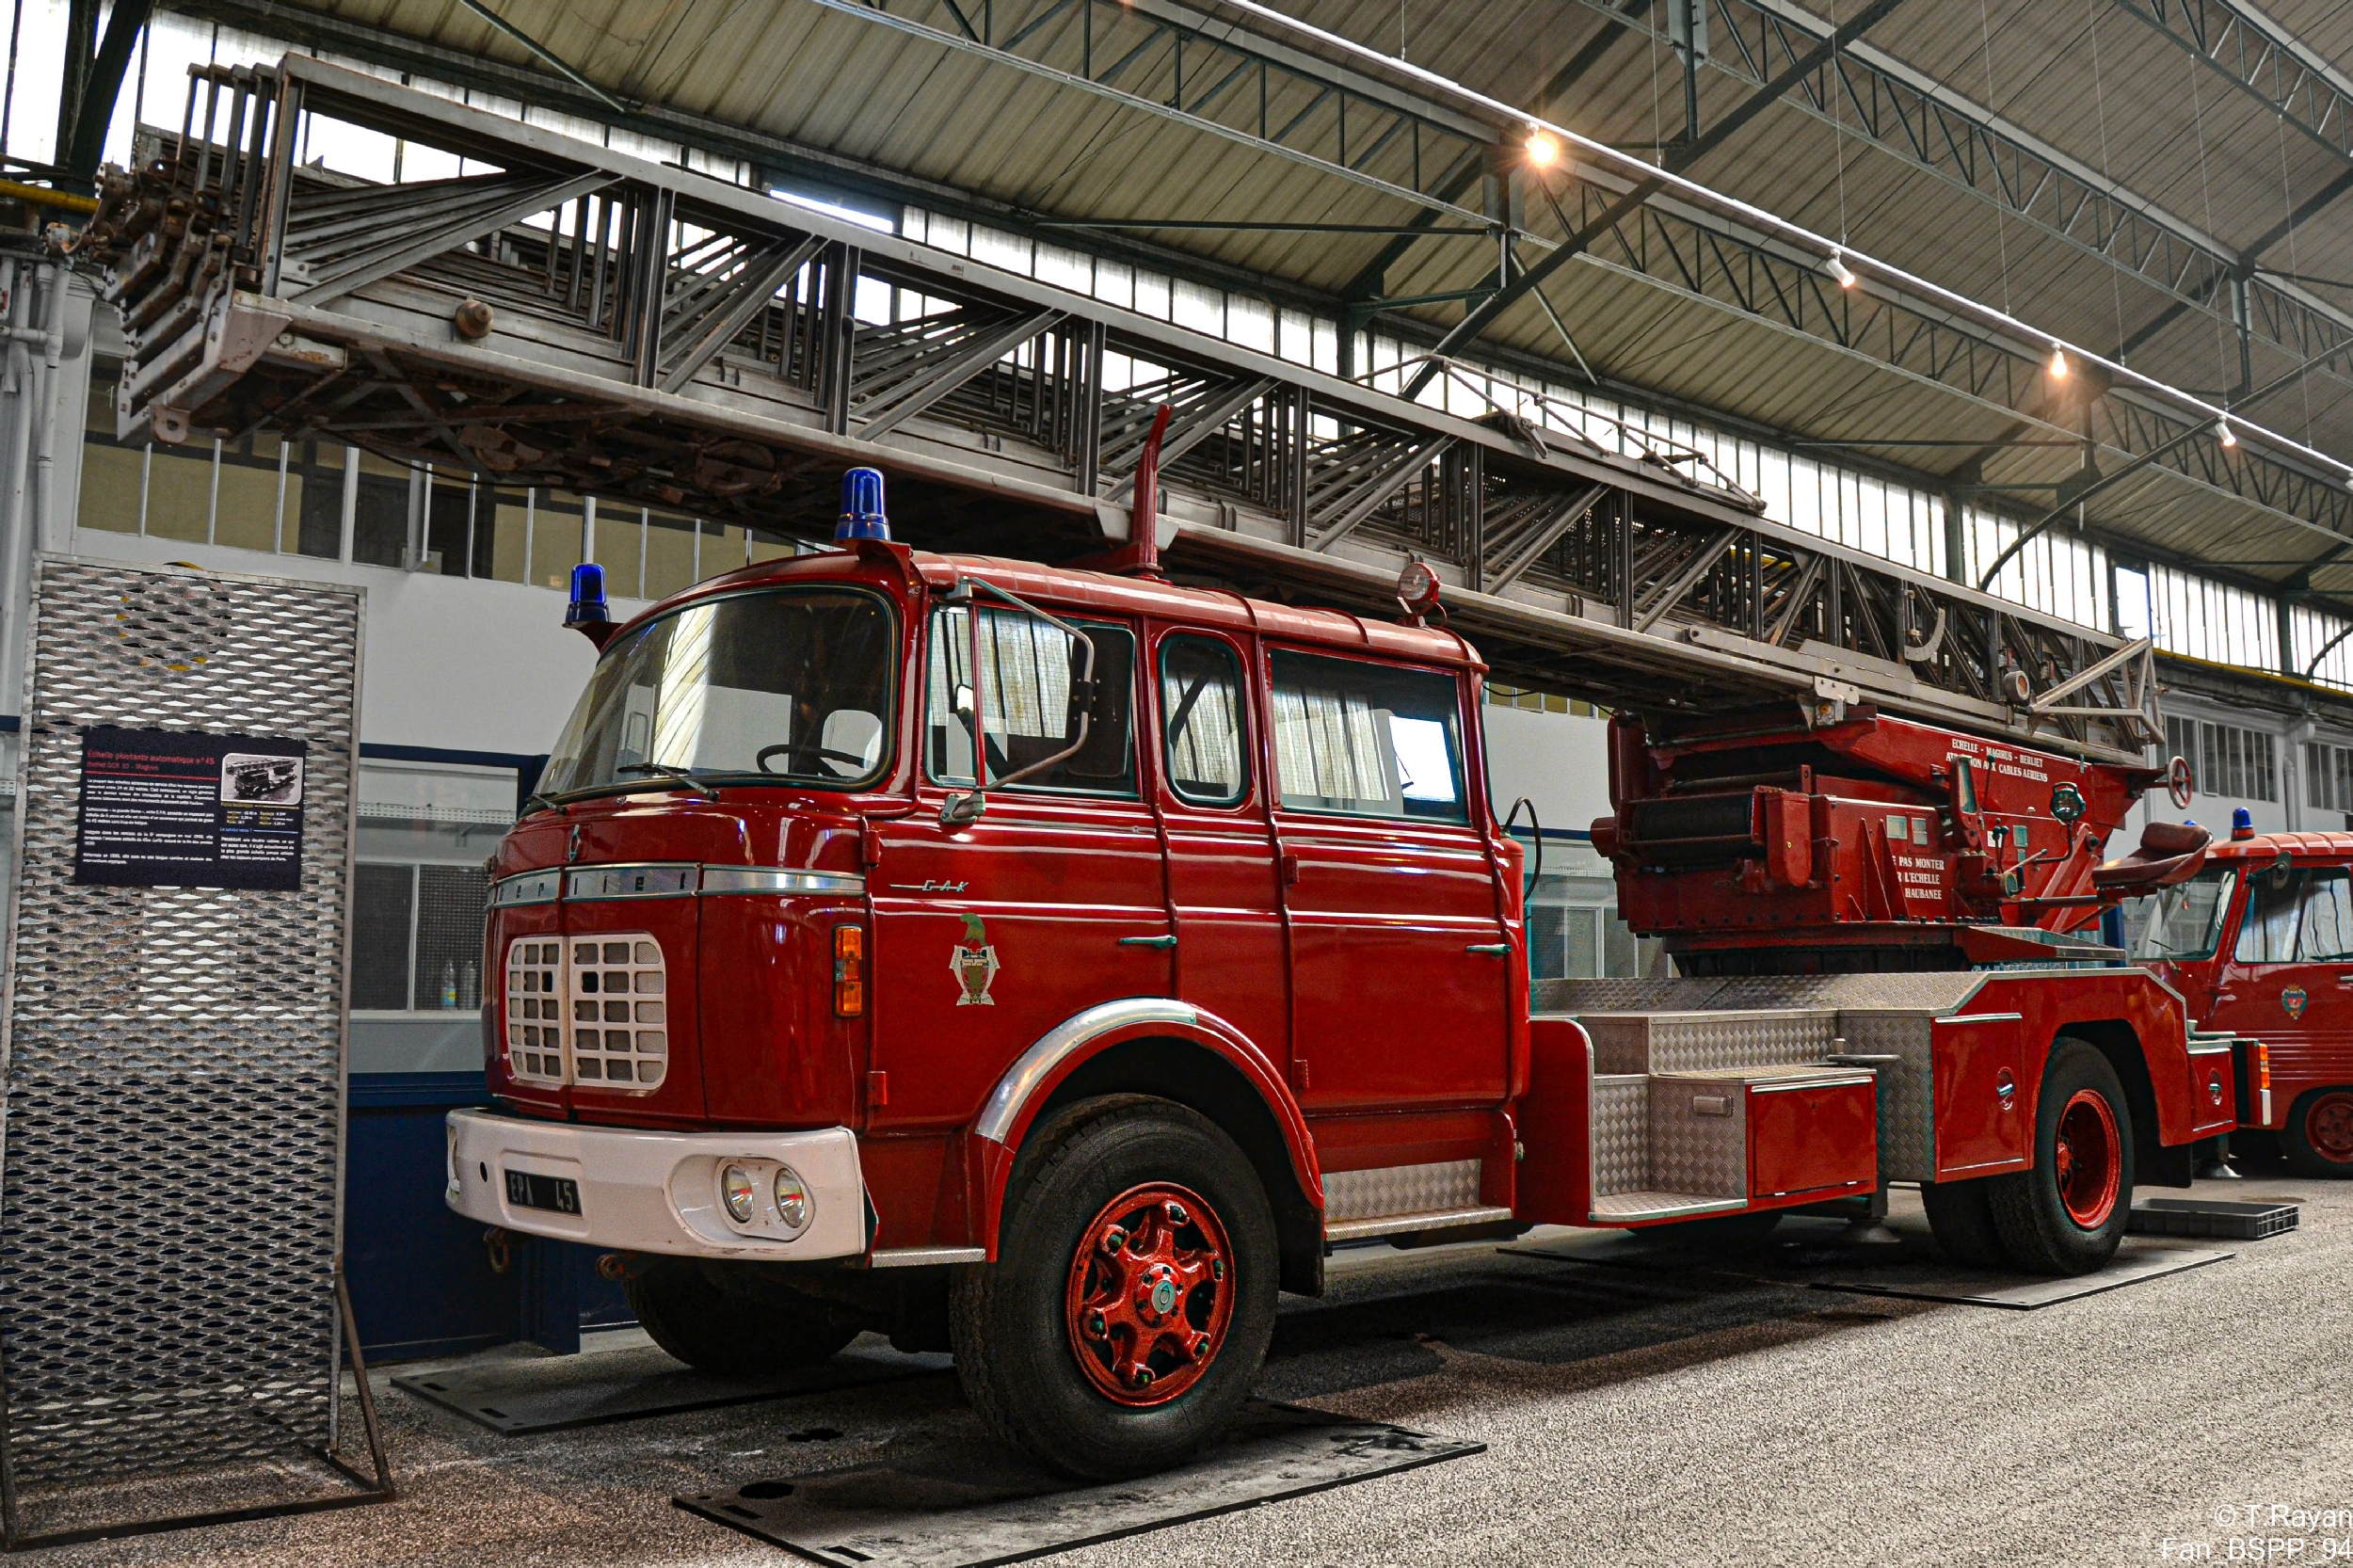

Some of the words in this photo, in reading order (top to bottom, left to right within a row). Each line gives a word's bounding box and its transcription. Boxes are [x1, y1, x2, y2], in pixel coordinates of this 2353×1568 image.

[1952, 739, 1978, 753] ECHELLE
[1986, 746, 2013, 761] MAGIRUS
[2020, 755, 2043, 768] BERLIET
[1998, 763, 2022, 776] CABLES
[2023, 769, 2048, 782] AERIENS
[1898, 856, 1913, 867] PAS
[1914, 857, 1945, 871] MONTER
[1905, 872, 1941, 885] L'ECHELLE
[1904, 888, 1943, 900] HAUBANEE
[509, 1173, 535, 1207] EPA
[555, 1180, 573, 1212] 45
